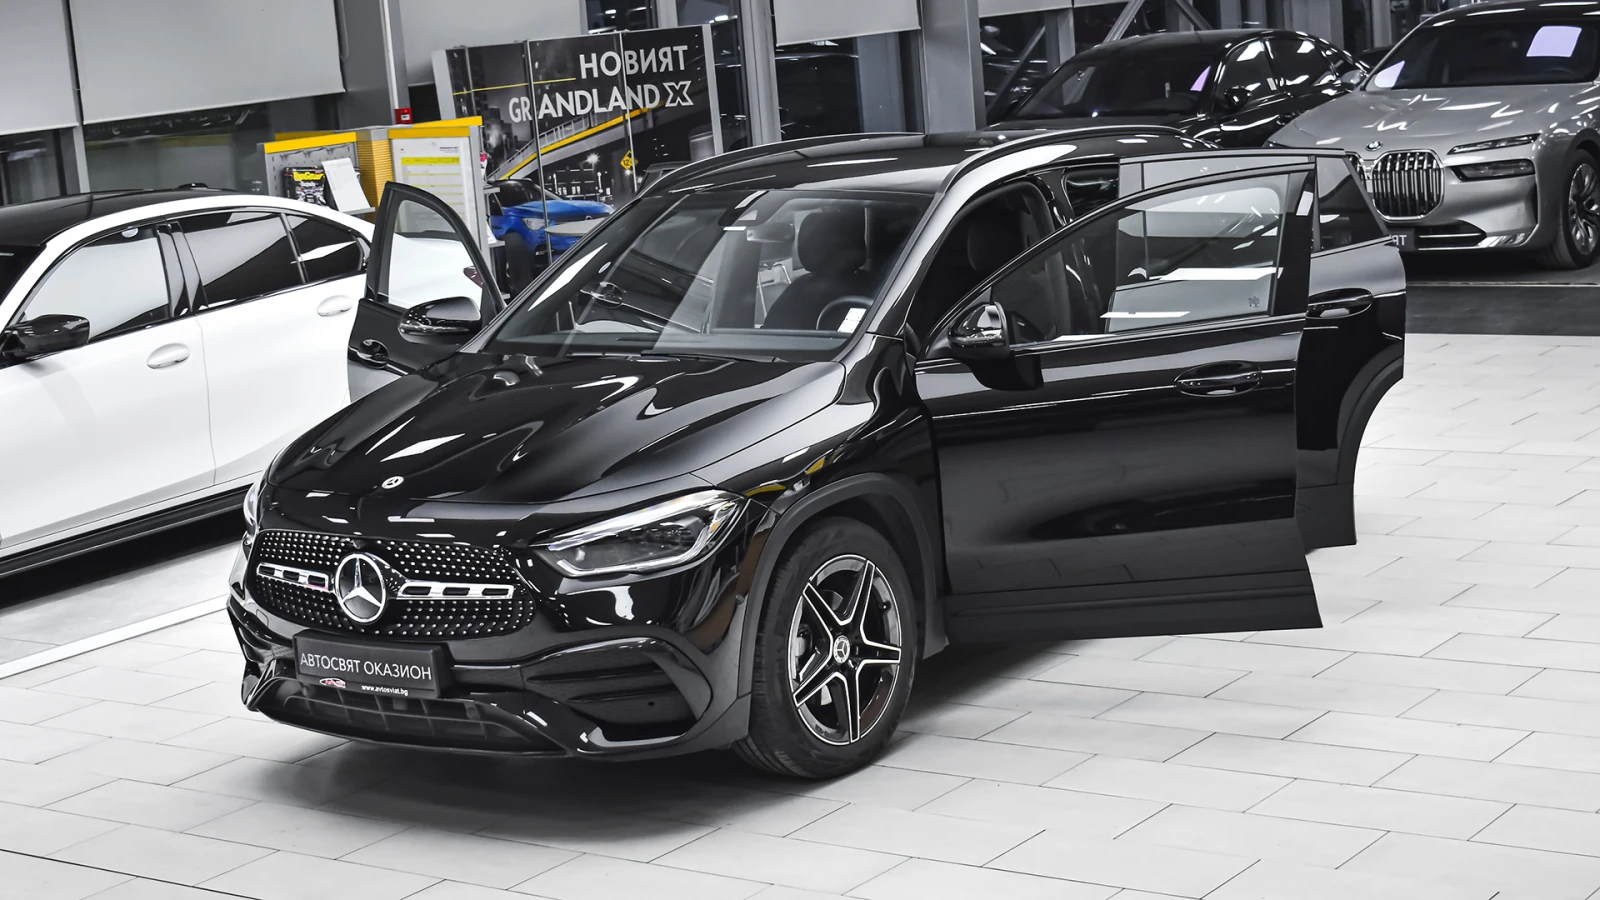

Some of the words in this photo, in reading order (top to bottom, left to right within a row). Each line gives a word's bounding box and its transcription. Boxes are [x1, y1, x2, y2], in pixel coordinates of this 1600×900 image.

[579, 45, 688, 79] НОВИЯТ
[508, 84, 661, 123] GRANDLAND
[662, 81, 694, 107] X
[300, 653, 361, 673] АВТОСВЯТ
[363, 661, 432, 680] ОКАЗИОН
[361, 685, 408, 696] www.avtosviat.bg
